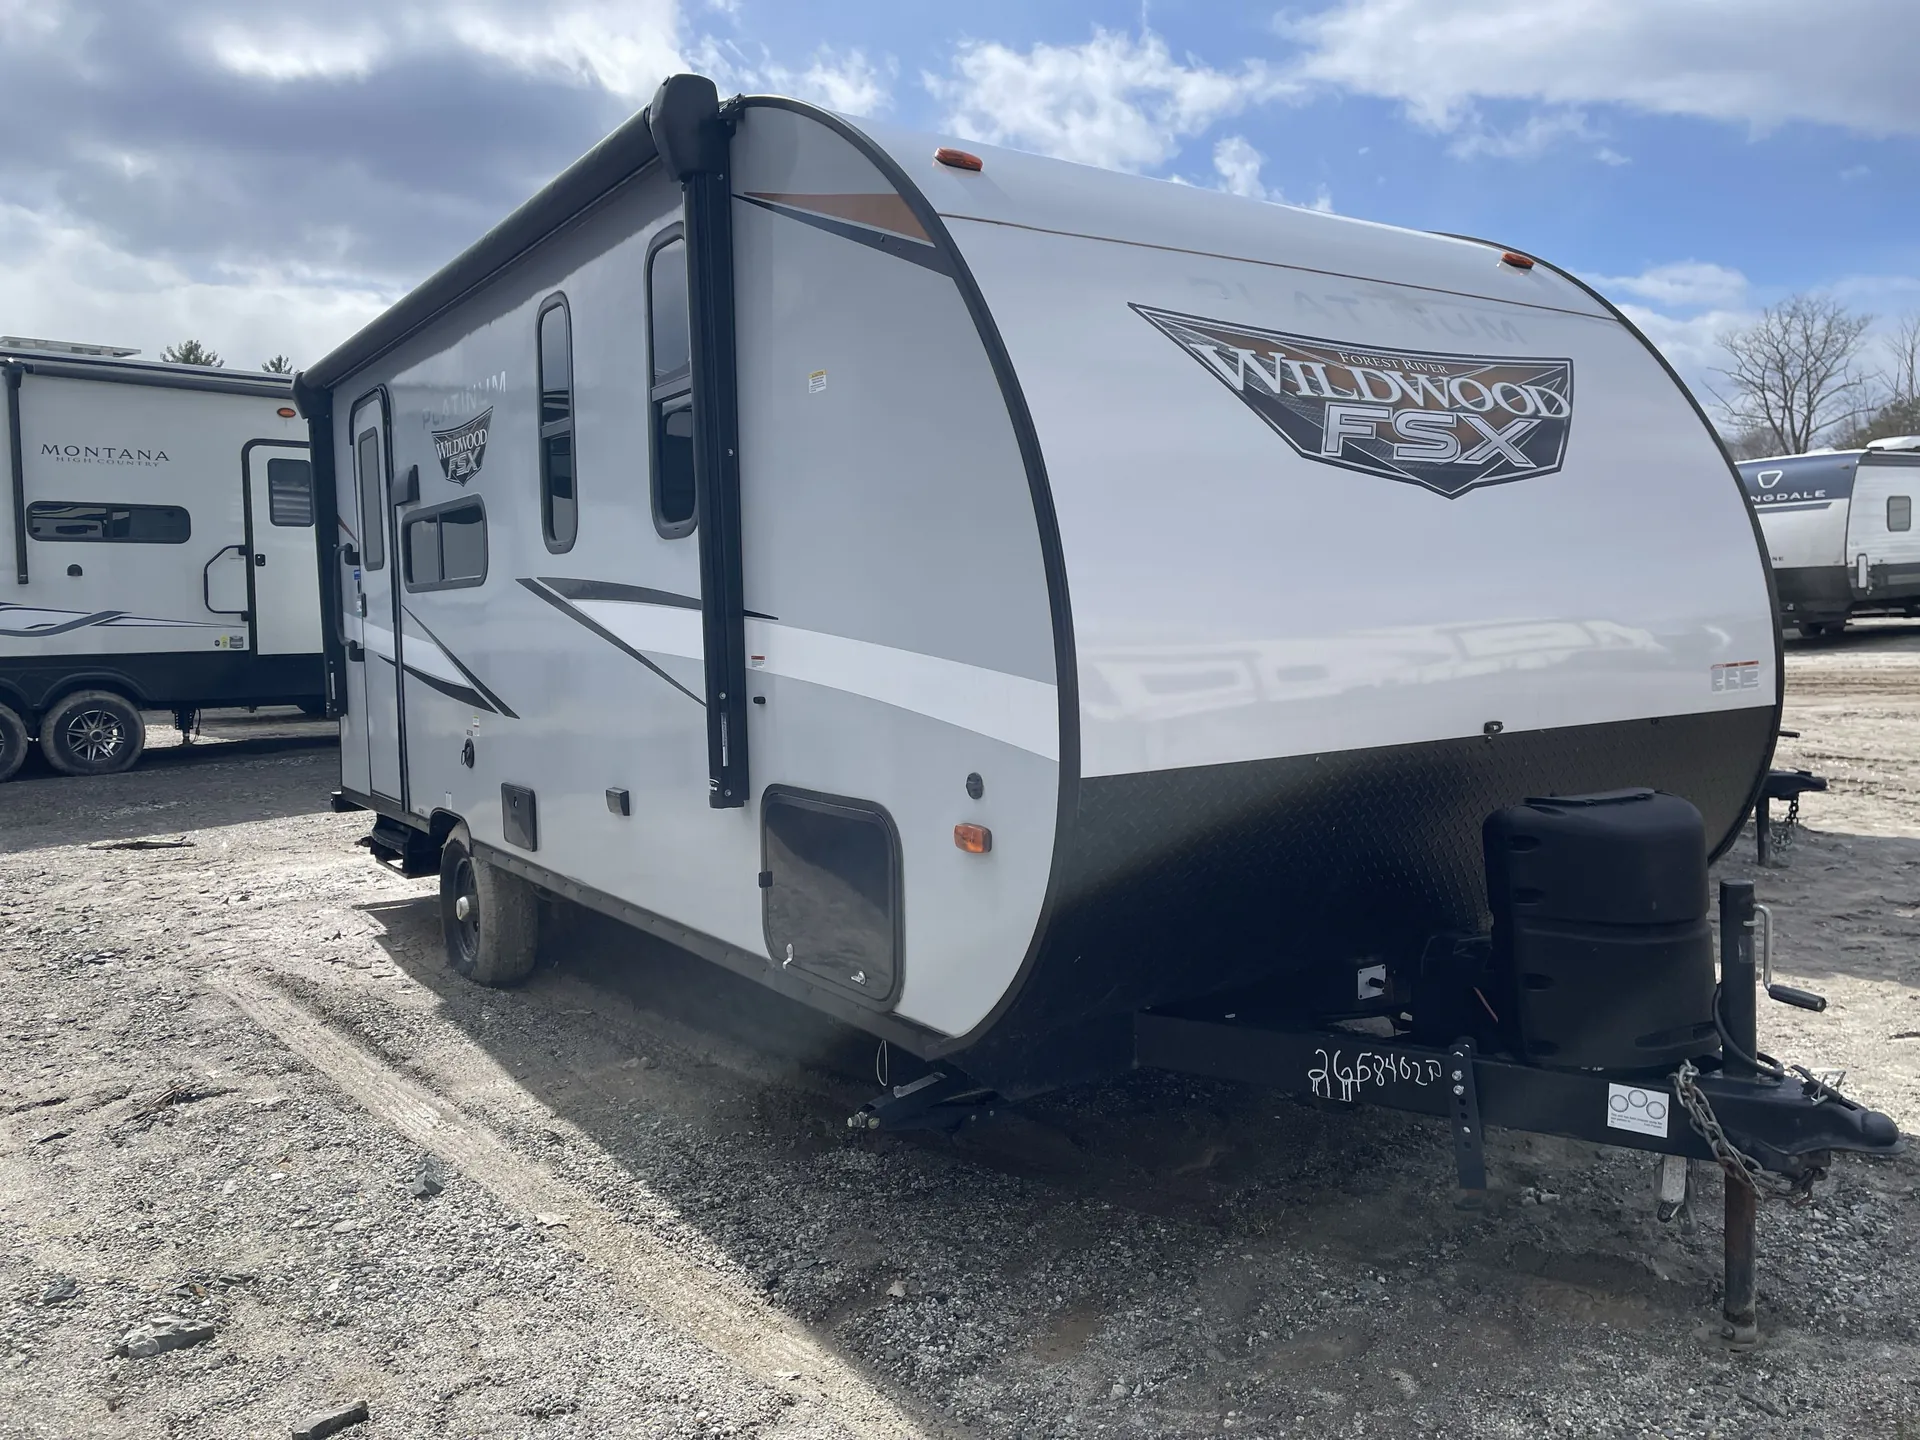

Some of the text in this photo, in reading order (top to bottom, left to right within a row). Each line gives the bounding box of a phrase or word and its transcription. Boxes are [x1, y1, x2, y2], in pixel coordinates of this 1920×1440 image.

[1338, 351, 1450, 374] FOREST RIVER
[1189, 342, 1572, 419] WILDWOOD
[435, 428, 488, 460] WILDWOOD
[1321, 401, 1543, 468] FSX
[41, 443, 170, 462] MONTANA
[56, 456, 159, 468] HIGH COUNTRY
[447, 446, 481, 479] FSX
